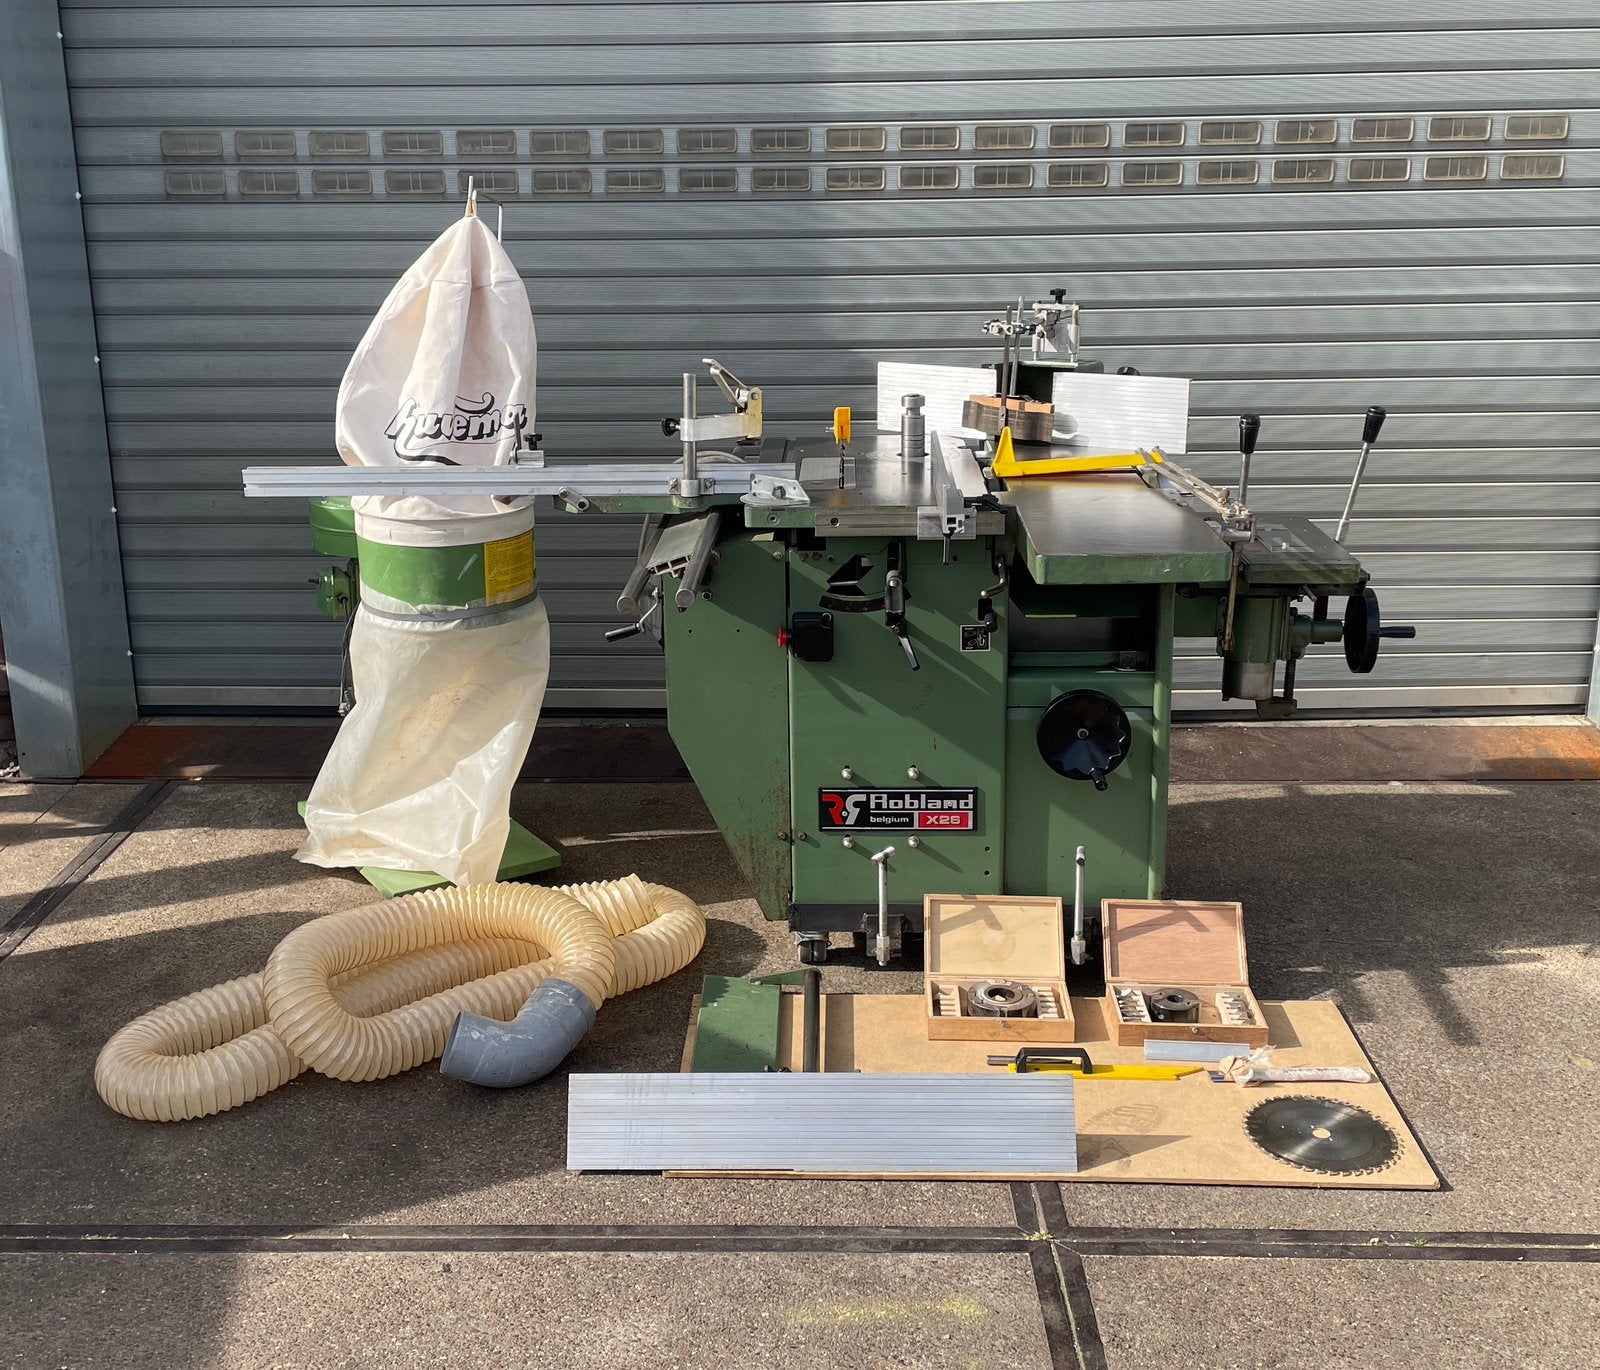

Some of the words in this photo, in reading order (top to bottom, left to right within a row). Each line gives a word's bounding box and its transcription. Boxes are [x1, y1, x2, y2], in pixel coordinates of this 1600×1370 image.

[870, 793, 973, 809] Robland
[870, 815, 909, 824] belgium
[926, 815, 961, 825] X26
